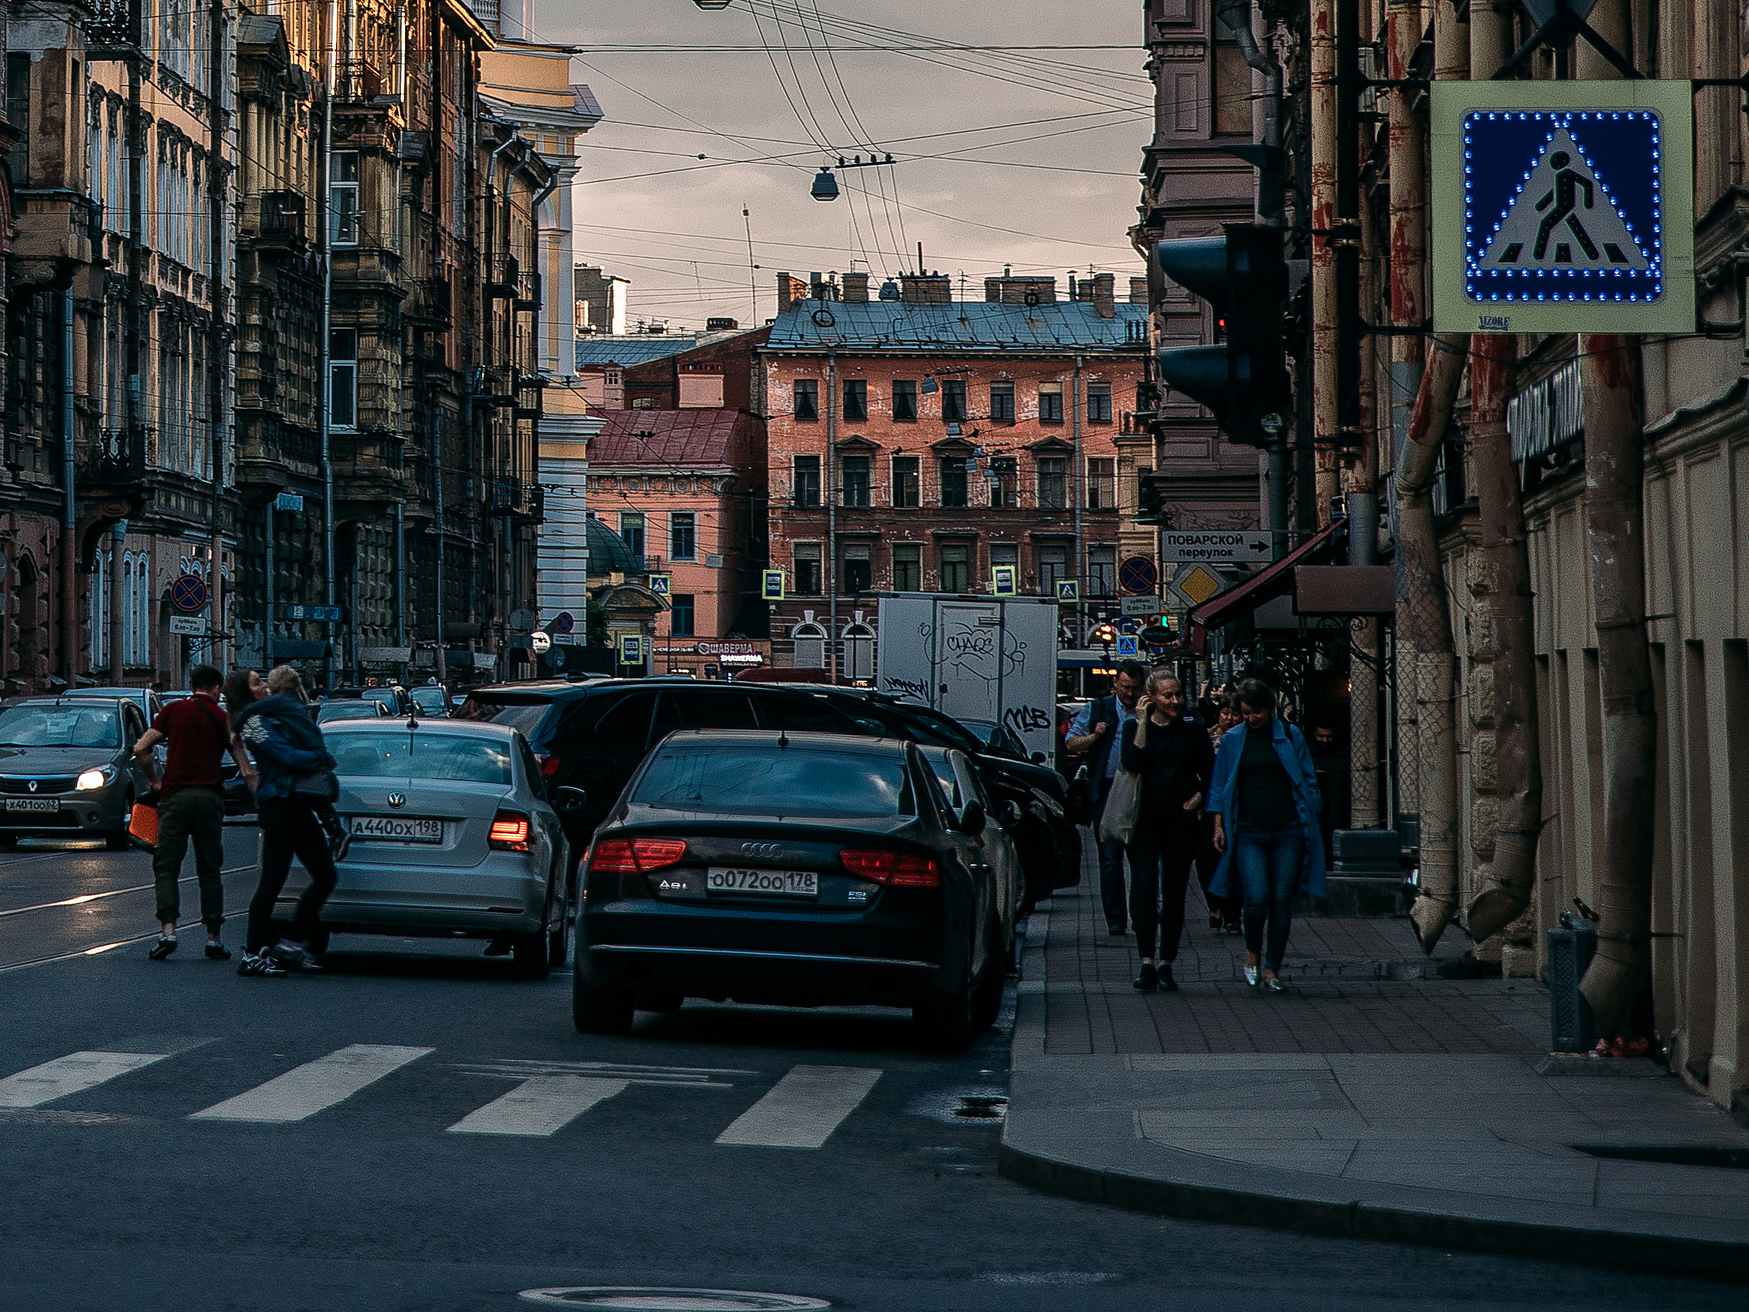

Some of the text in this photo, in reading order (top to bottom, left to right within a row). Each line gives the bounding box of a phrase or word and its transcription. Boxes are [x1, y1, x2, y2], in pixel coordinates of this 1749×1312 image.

[1167, 533, 1244, 546] ПОВАРСКОЙ
[1178, 548, 1234, 558] переулок
[710, 642, 753, 654] ШАВЕРМА
[354, 818, 439, 836] А440ОХ 198
[711, 869, 813, 890] О072ОО 178
